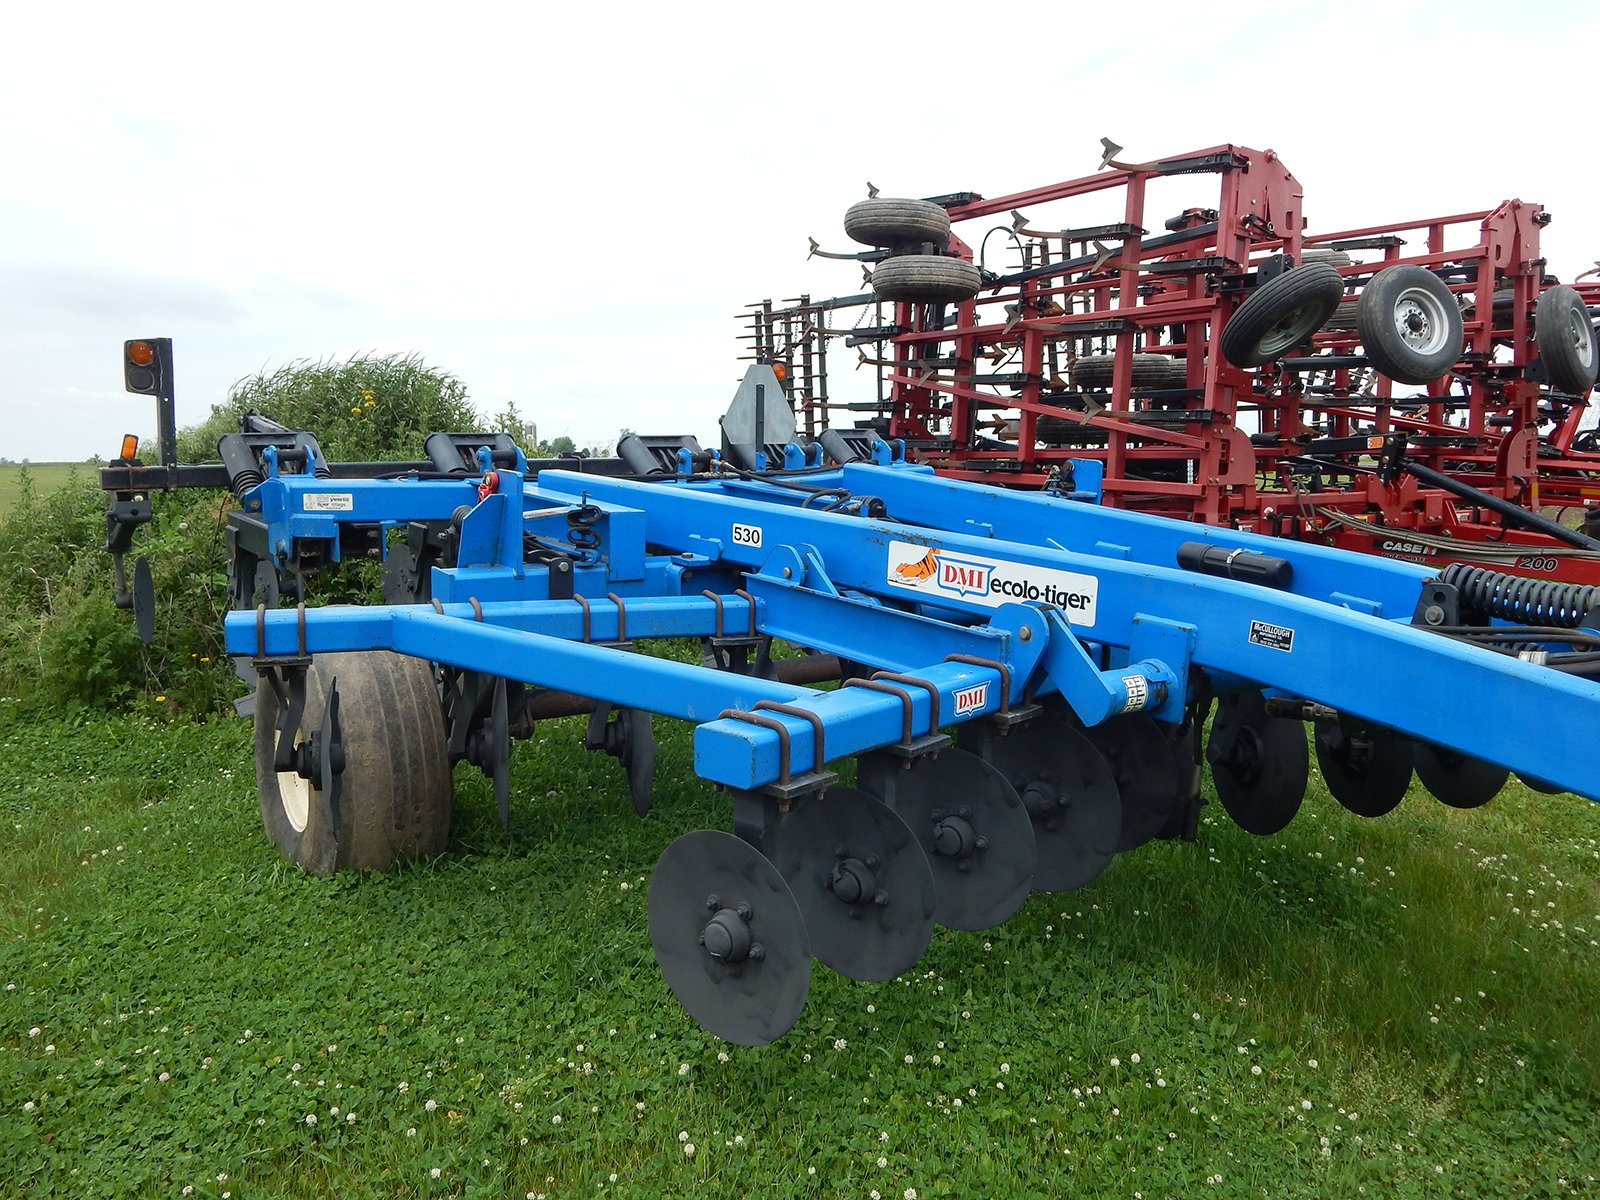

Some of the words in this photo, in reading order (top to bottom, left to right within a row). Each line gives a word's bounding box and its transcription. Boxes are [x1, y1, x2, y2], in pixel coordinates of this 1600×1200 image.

[734, 526, 760, 544] 530
[1519, 556, 1558, 572] 200
[944, 565, 984, 589] DMI
[990, 578, 1091, 611] ecolo-tiger
[959, 689, 983, 710] DMI
